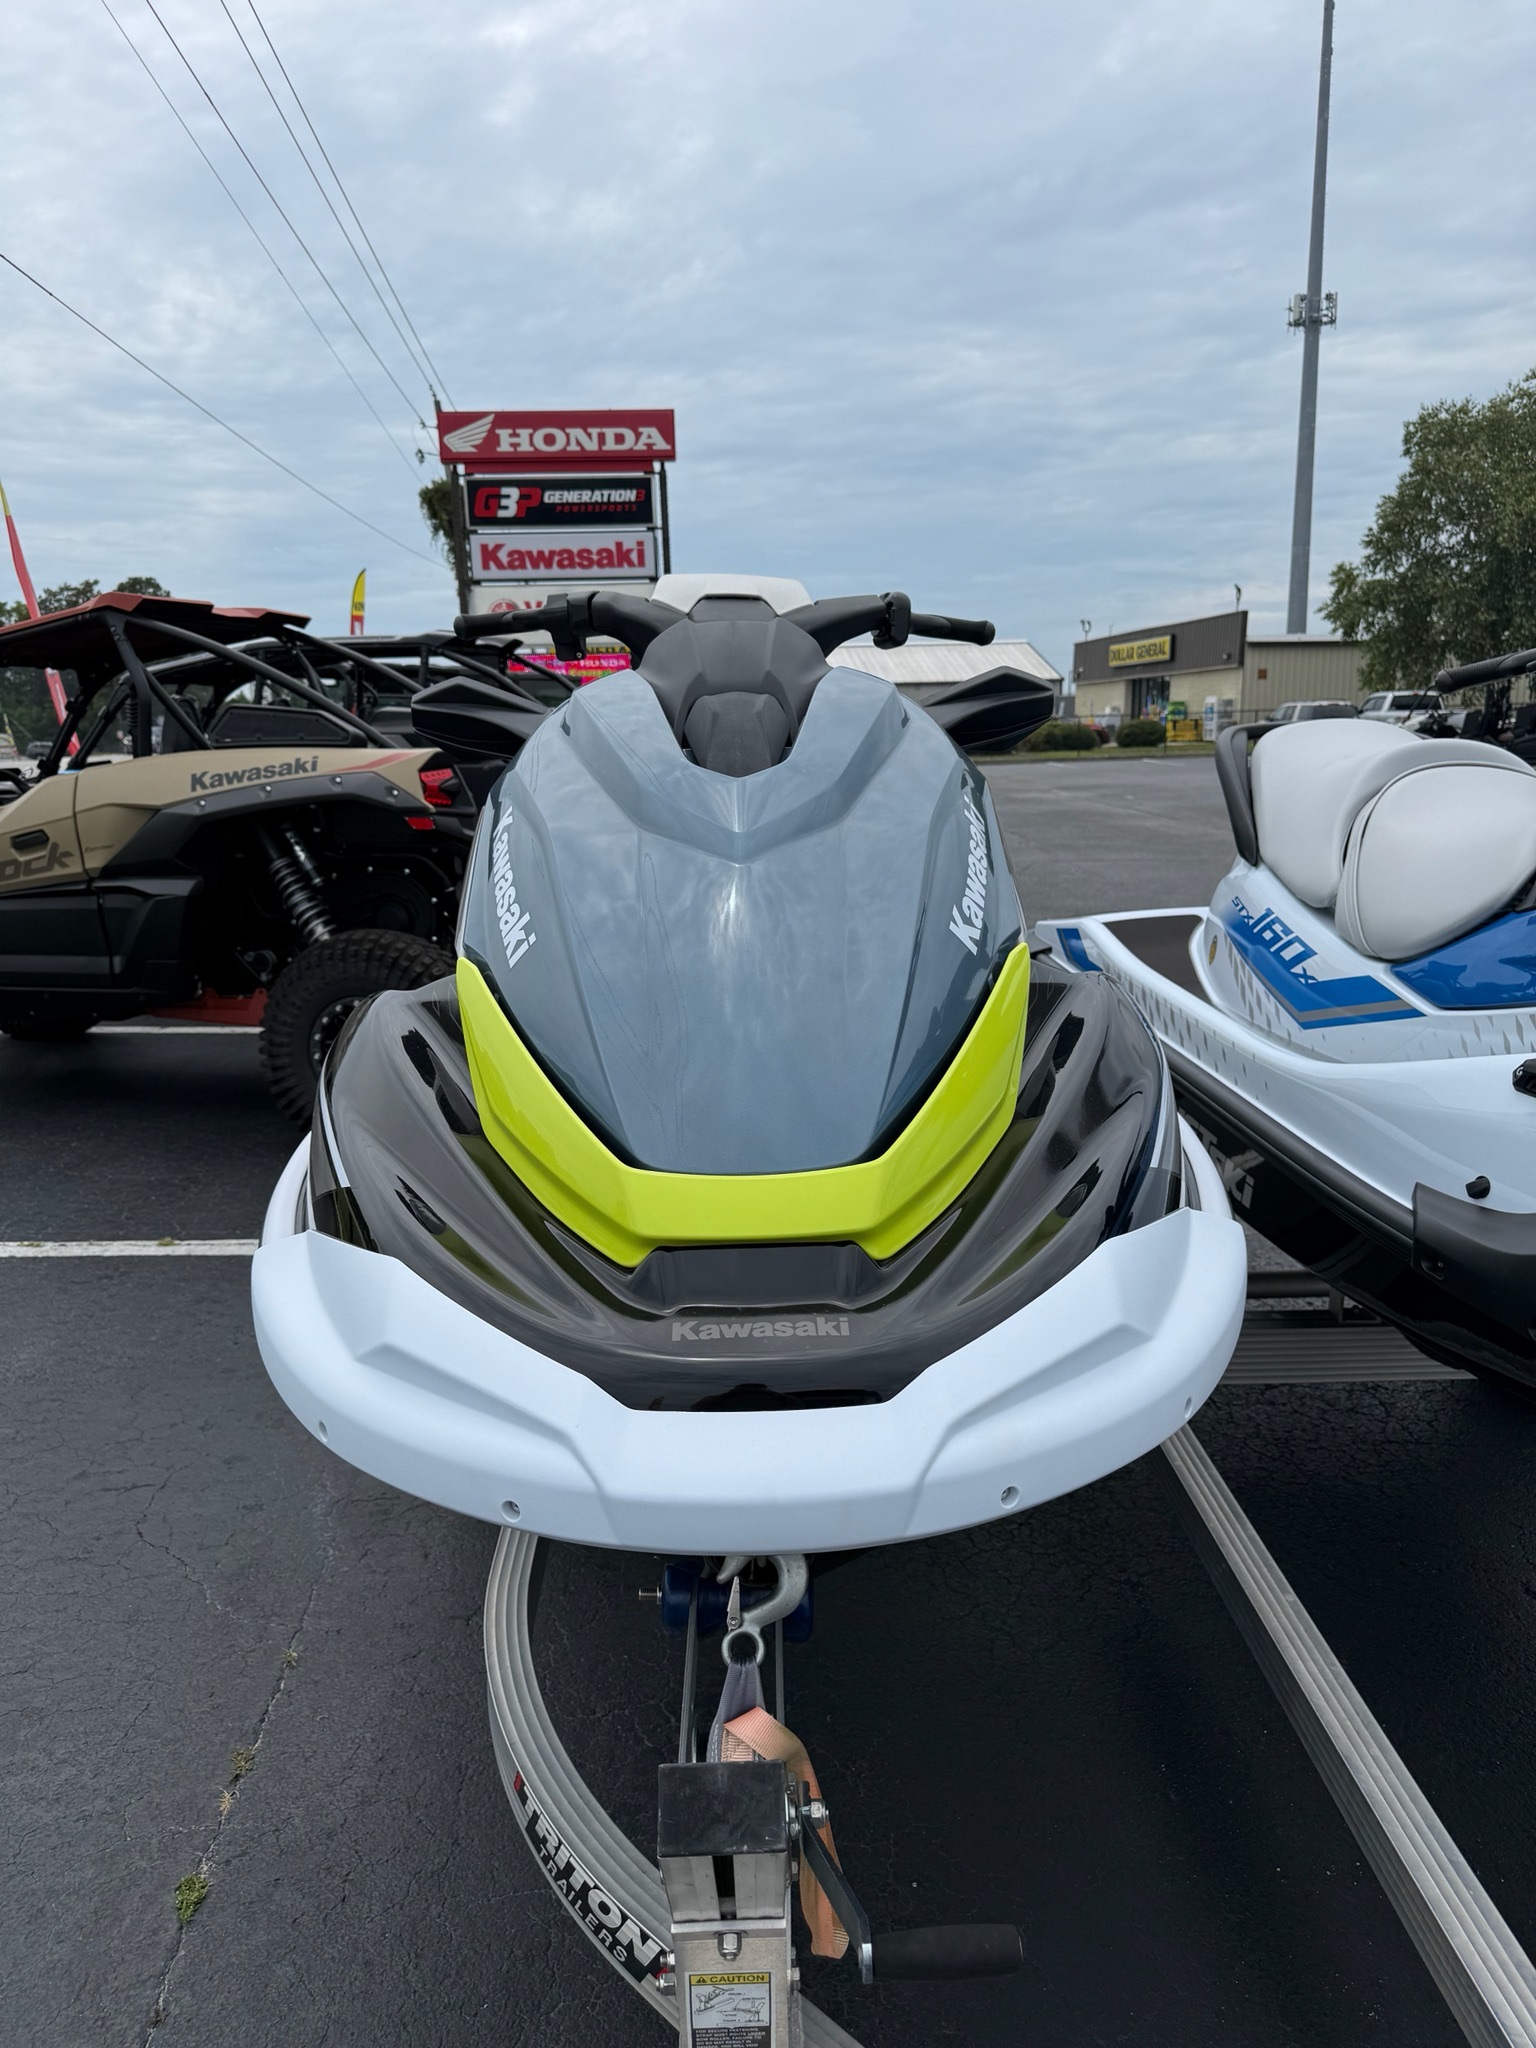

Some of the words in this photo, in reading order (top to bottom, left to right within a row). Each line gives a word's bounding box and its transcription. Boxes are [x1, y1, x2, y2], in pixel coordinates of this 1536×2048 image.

[495, 427, 672, 452] HONDA
[473, 486, 542, 518] G3P
[555, 504, 638, 513] POWERSPORTS
[479, 540, 646, 571] Kawasaki
[190, 755, 319, 793] Kawasaki
[492, 805, 537, 969] Kawasaki
[949, 794, 989, 956] Kawasaki
[1231, 895, 1254, 926] STX
[671, 1316, 851, 1342] Kawasaki
[523, 1784, 662, 1967] TRITON
[539, 1843, 629, 1963] TRAILERS
[709, 1974, 765, 1984] CAUTION
